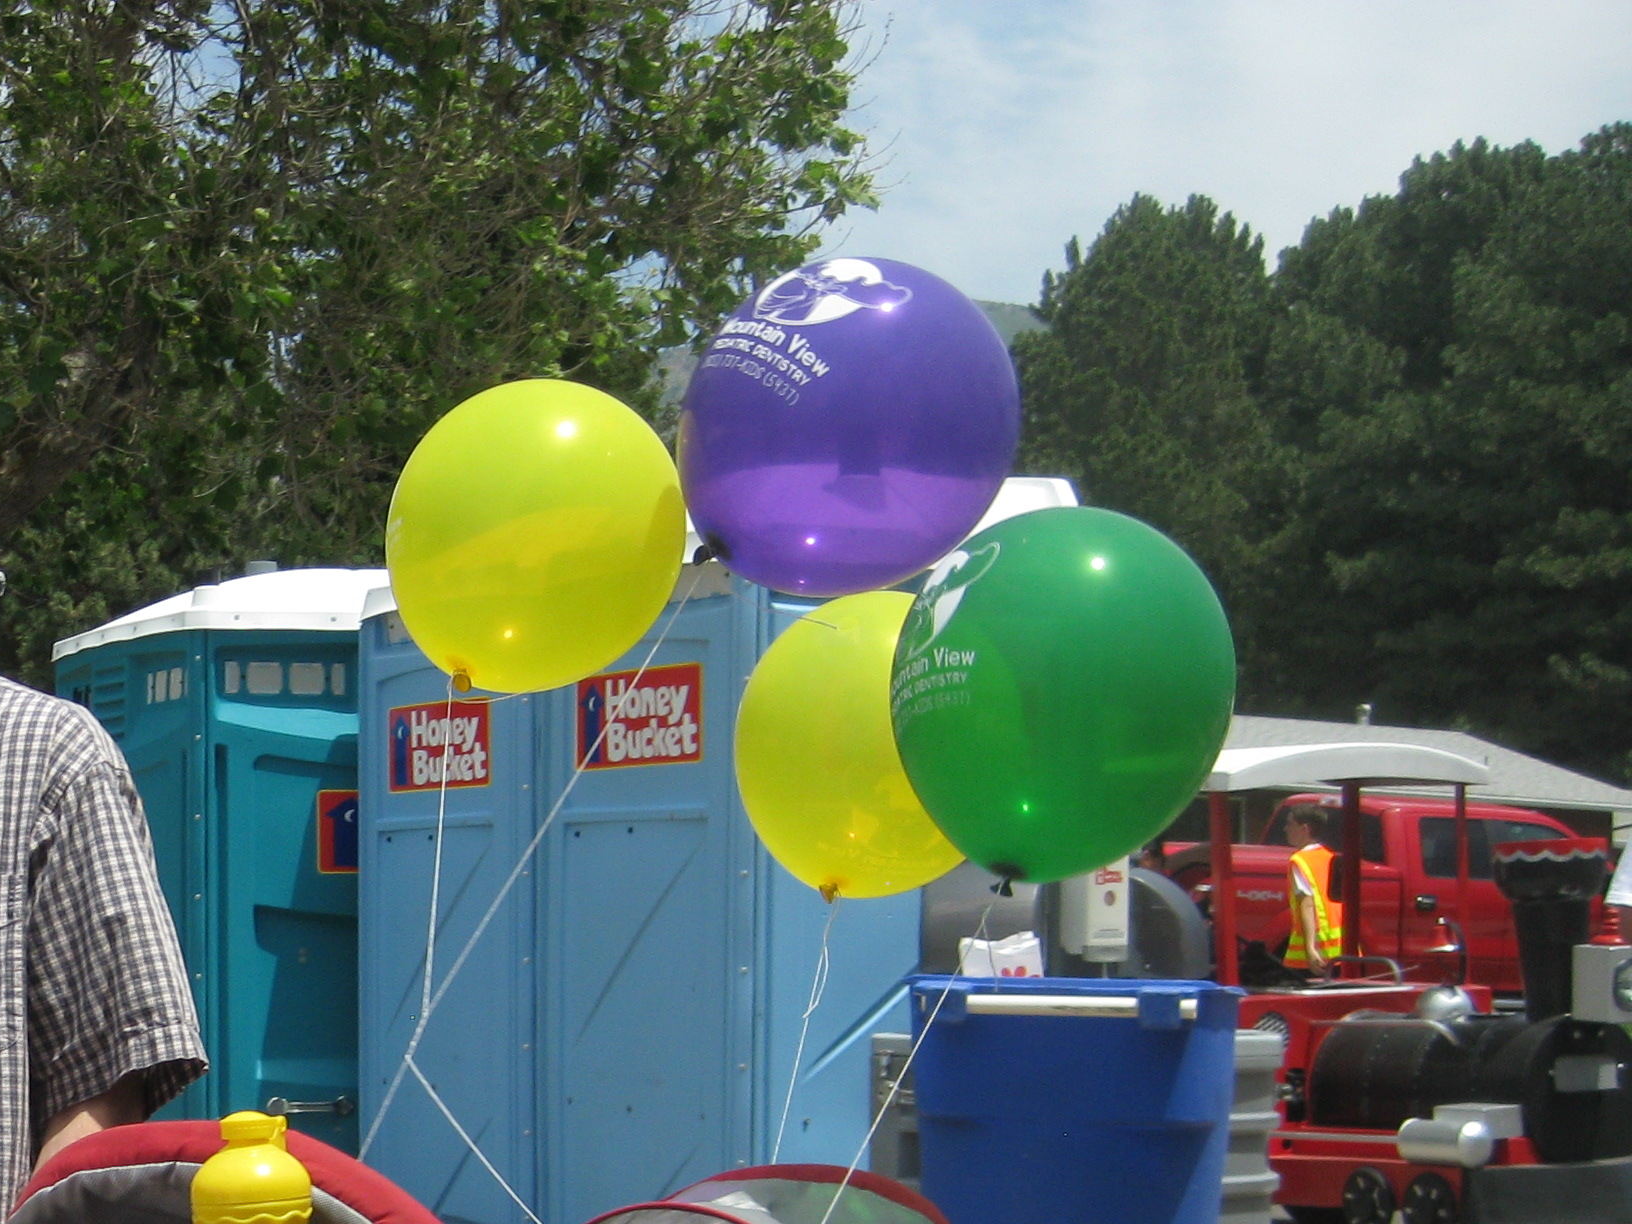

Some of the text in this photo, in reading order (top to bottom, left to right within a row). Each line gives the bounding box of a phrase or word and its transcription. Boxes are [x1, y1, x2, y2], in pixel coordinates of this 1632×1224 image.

[752, 344, 811, 386] DENTISTRY
[787, 333, 830, 377] View
[762, 371, 799, 406] (5437)
[933, 647, 976, 668] View
[605, 679, 689, 724] Honey
[410, 710, 479, 752] Honey
[606, 712, 698, 762] Bucket
[412, 742, 487, 785] Bucket
